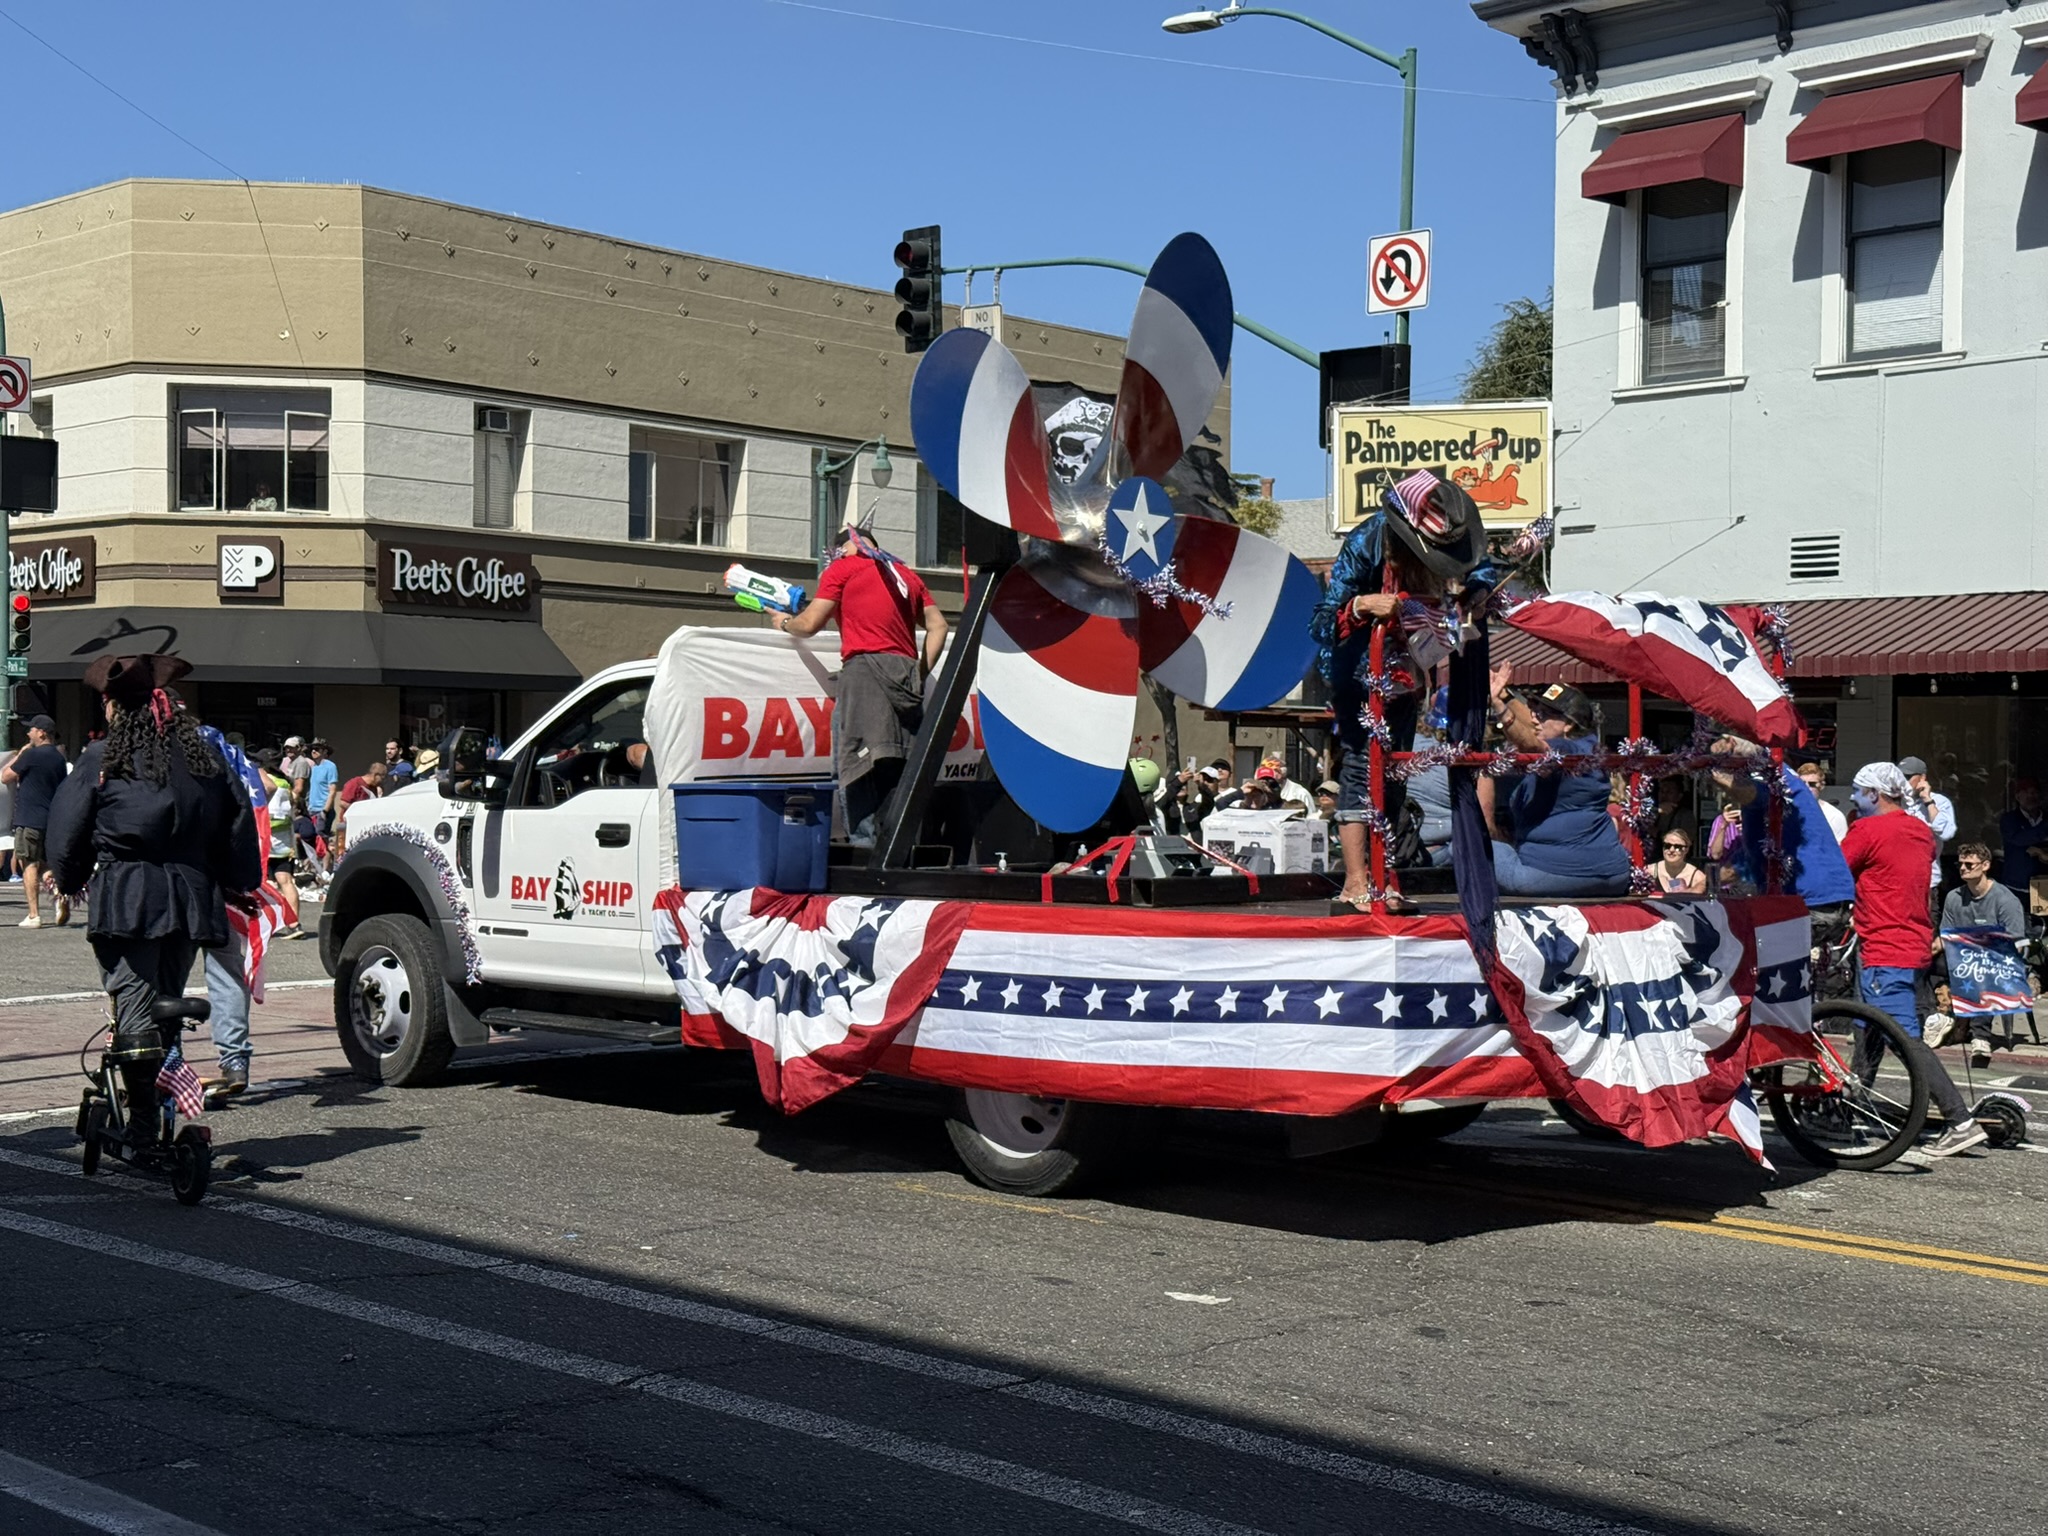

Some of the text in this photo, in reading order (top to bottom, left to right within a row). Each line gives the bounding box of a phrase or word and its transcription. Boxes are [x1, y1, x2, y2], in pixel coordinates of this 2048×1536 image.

[975, 311, 989, 323] NO
[1345, 427, 1541, 467] Pampered Pup
[1366, 419, 1396, 439] The
[39, 546, 82, 593] Coffee
[390, 548, 526, 604] Peet's Coffee
[701, 697, 836, 760] BAY
[511, 875, 633, 907] BAY SHIP
